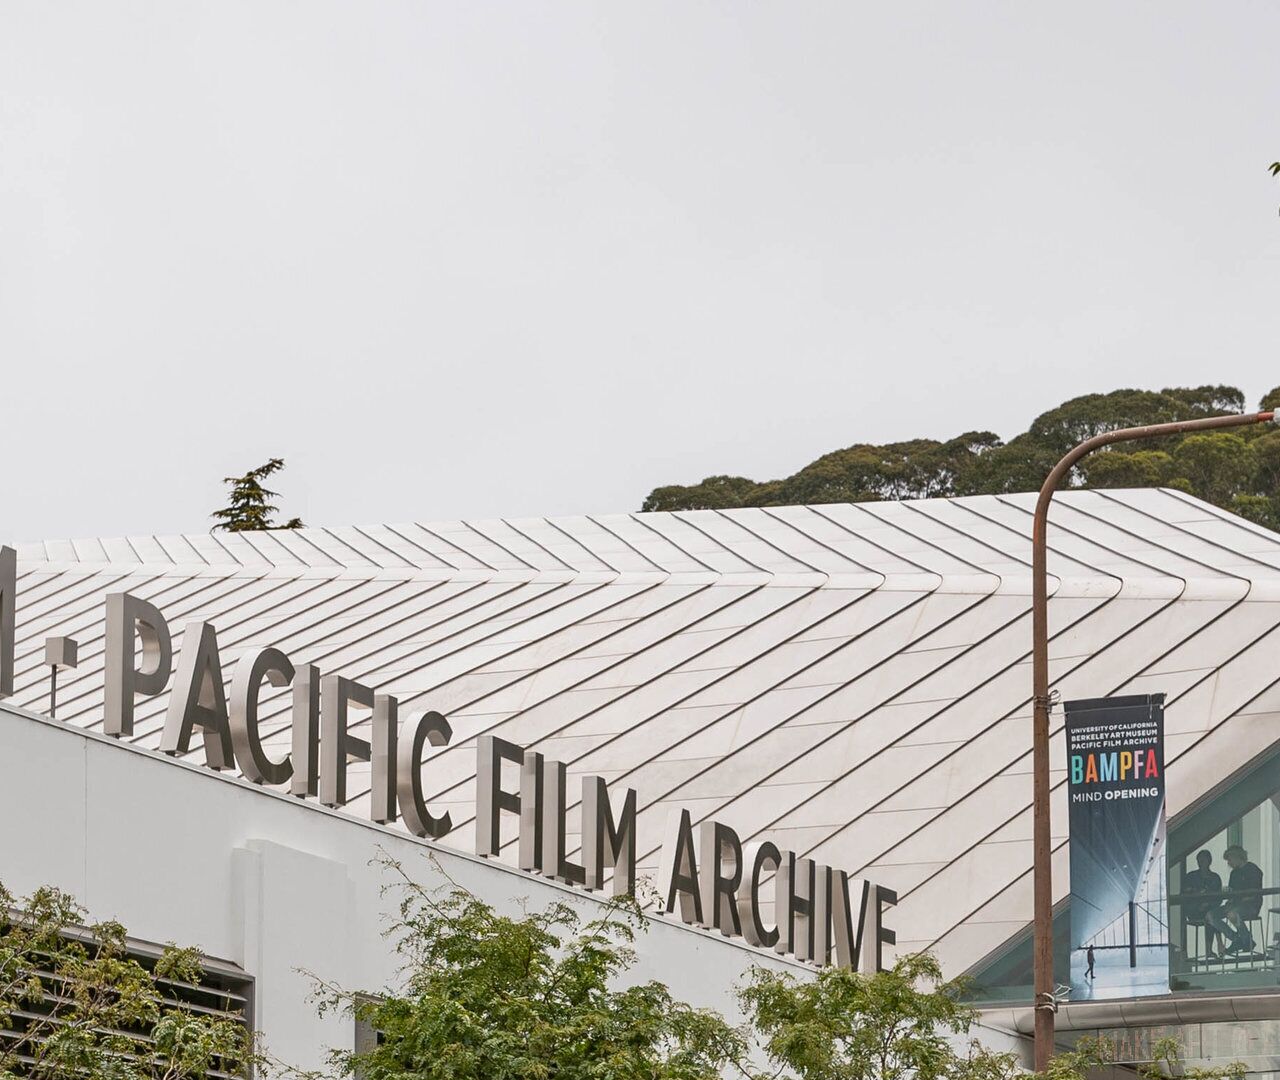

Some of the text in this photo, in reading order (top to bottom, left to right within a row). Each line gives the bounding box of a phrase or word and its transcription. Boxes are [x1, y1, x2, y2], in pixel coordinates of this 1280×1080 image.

[1071, 721, 1158, 734] UNIVERSITY OF CALIFORNIA
[1071, 729, 1158, 742] BERKELEY ART MUSEUM
[1071, 737, 1158, 750] PACIFIC FILM ARCHIVE
[1071, 748, 1159, 785] BAMPFA
[104, 592, 453, 837] PACIFIC
[476, 735, 637, 897] FILM
[658, 807, 898, 974] ARCHIVE
[1072, 787, 1159, 803] MIND OPENING
